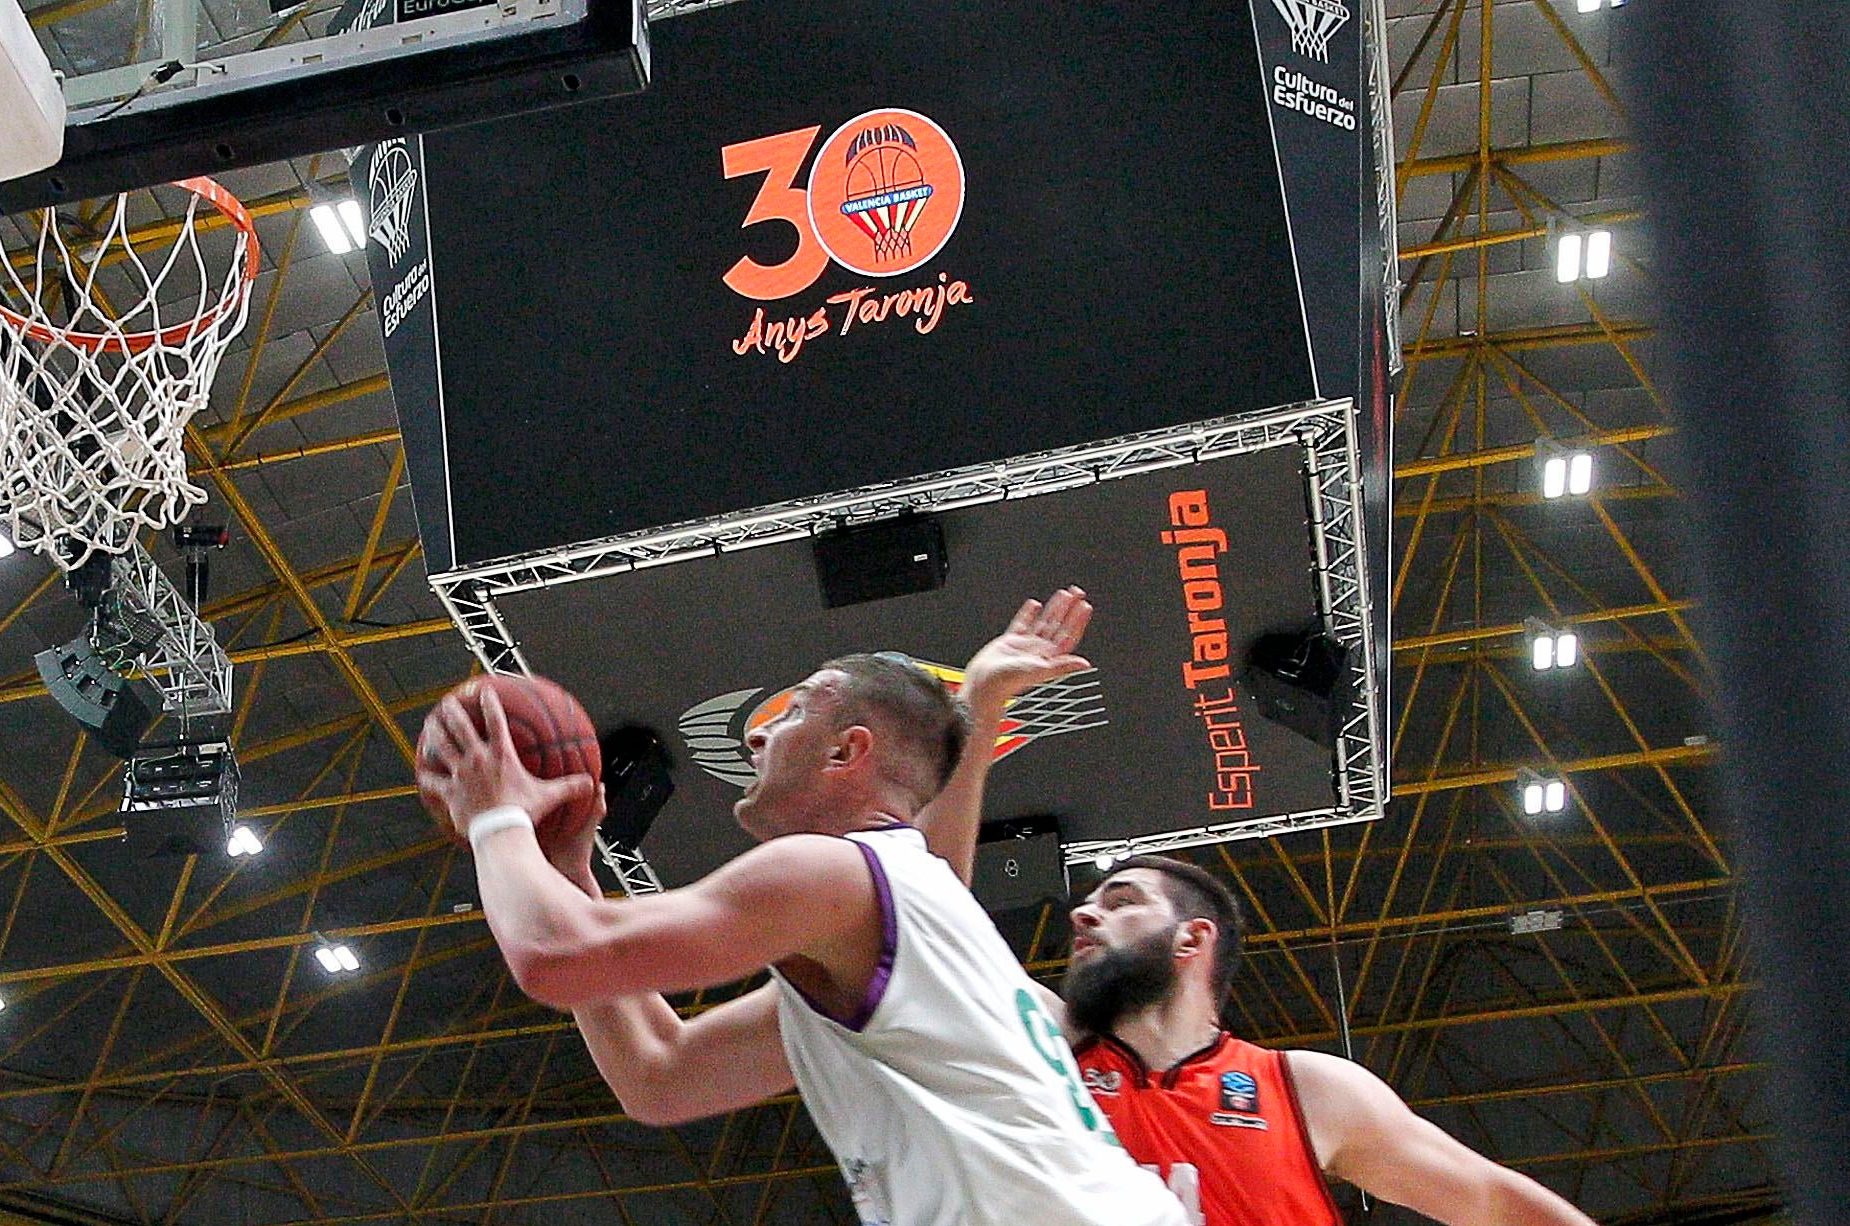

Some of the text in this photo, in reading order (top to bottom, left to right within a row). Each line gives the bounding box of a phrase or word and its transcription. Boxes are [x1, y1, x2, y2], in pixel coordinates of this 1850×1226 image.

[1273, 84, 1356, 130] Esfuerzo
[1274, 66, 1354, 112] Cultura del
[721, 107, 966, 300] 30
[844, 186, 929, 212] VALENCIA BASKET
[384, 267, 417, 316] Cultura
[384, 274, 429, 338] Esfuerzo
[732, 272, 973, 363] Anys Taronja
[1160, 489, 1261, 811] Esperit Taronja
